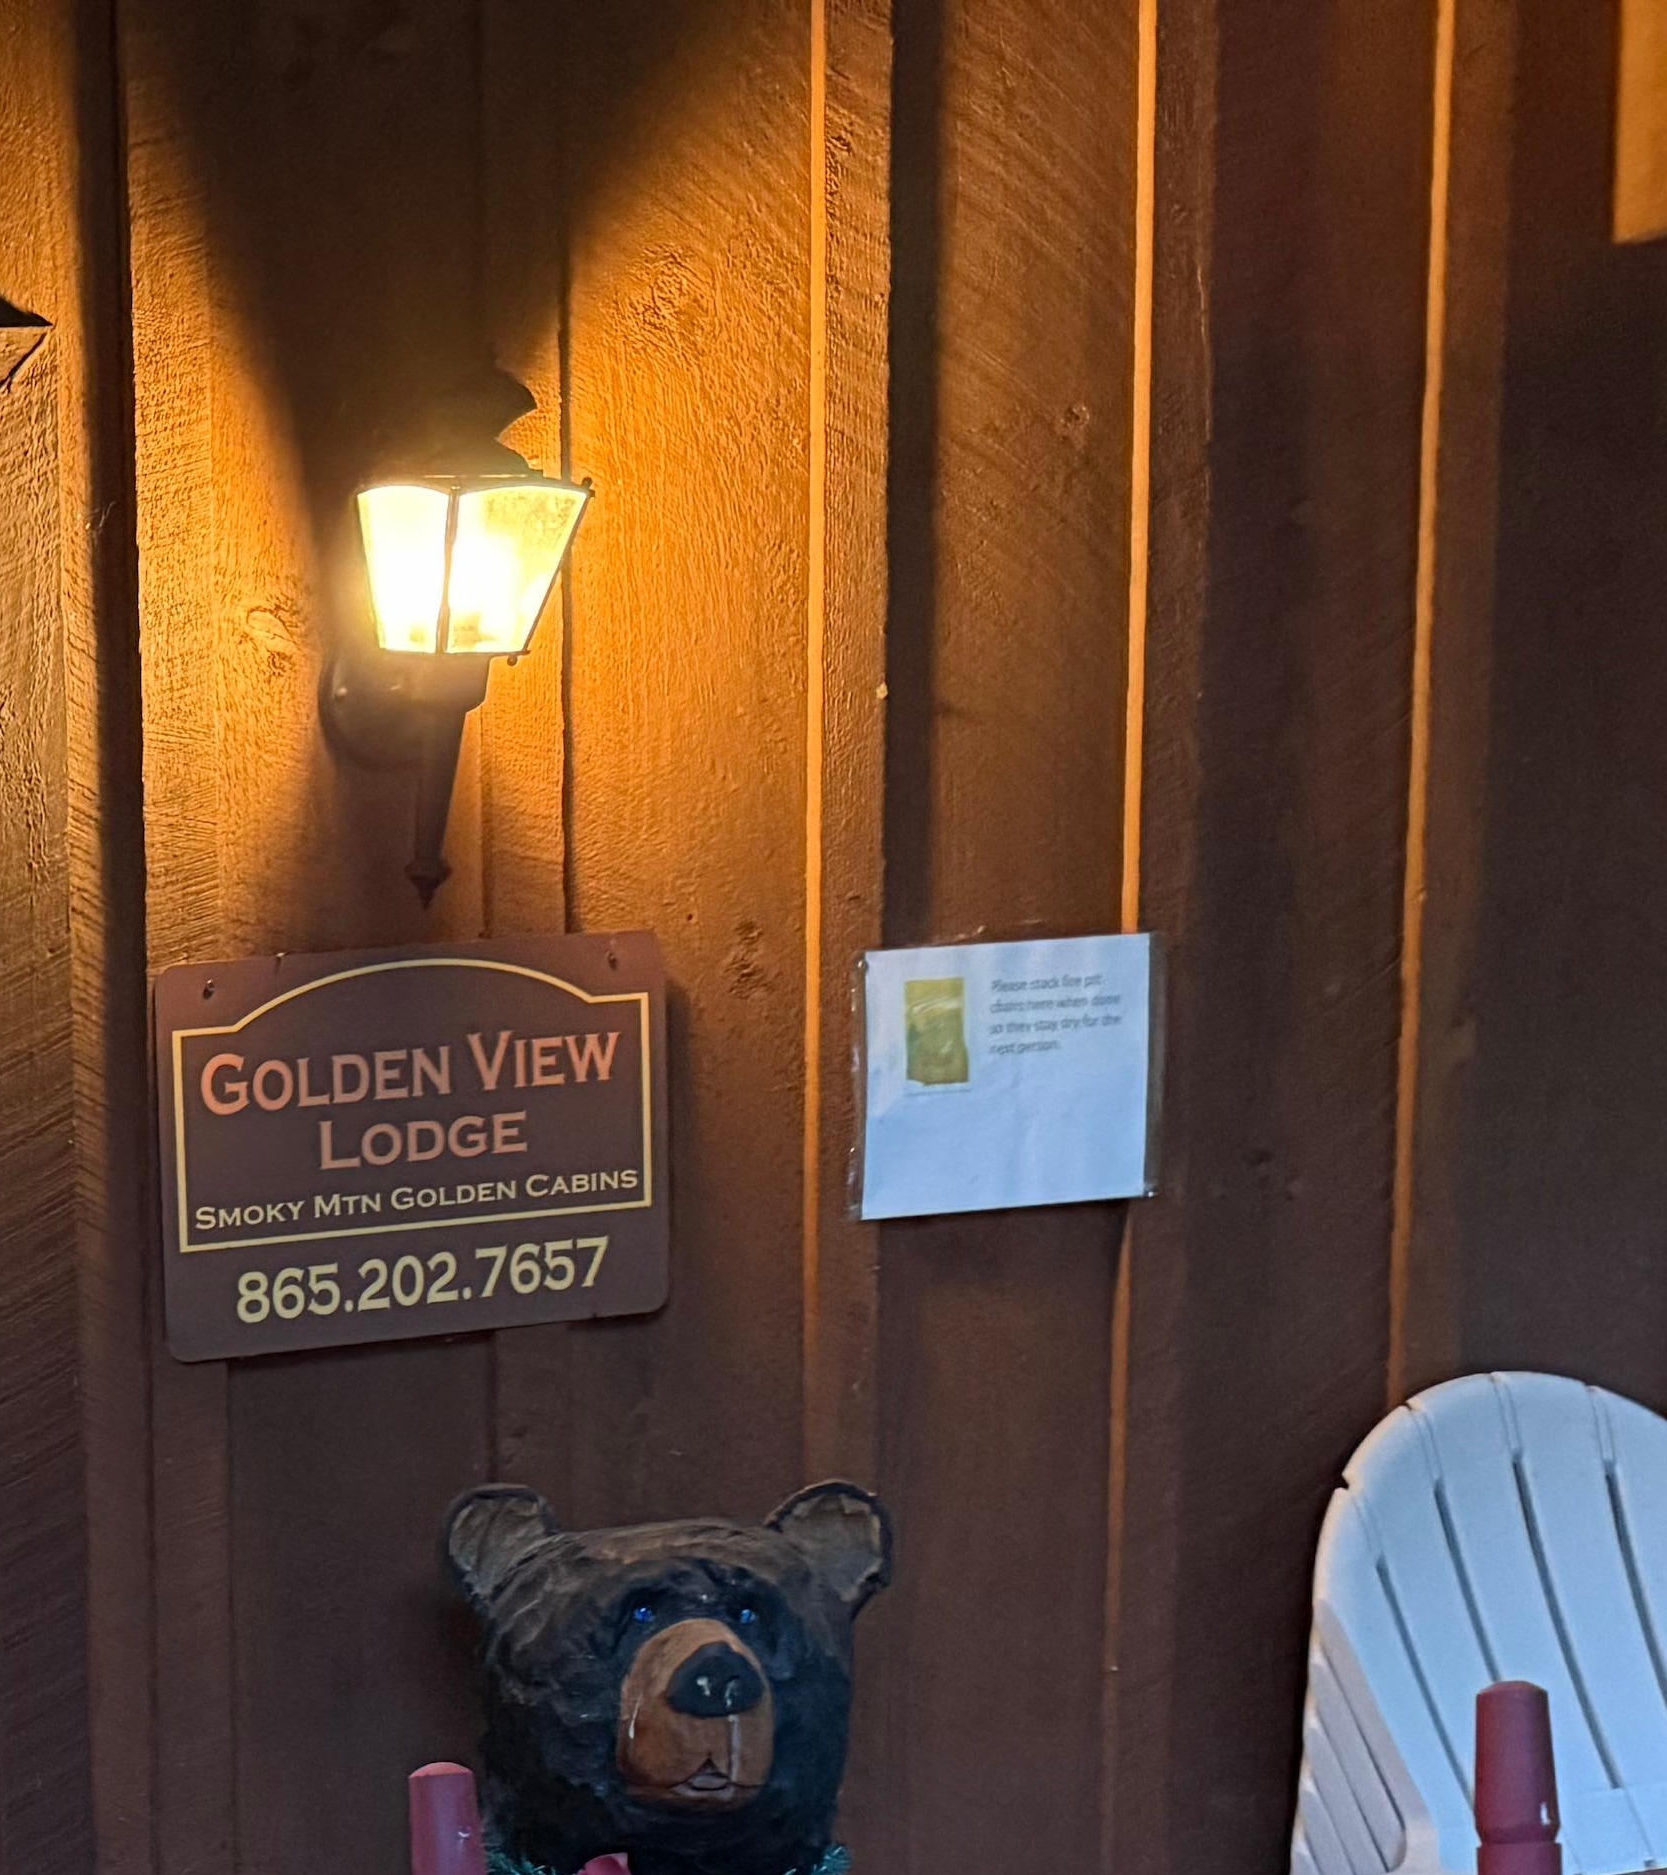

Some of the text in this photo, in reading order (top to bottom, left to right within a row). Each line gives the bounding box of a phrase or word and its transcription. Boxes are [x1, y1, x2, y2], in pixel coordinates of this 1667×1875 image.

[199, 1030, 621, 1117] GOLDEN VIEW
[318, 1110, 529, 1171] LODGE
[195, 1169, 639, 1231] SMOKY MTN GOLDEN CABINS
[236, 1235, 610, 1325] 865.202.7657
